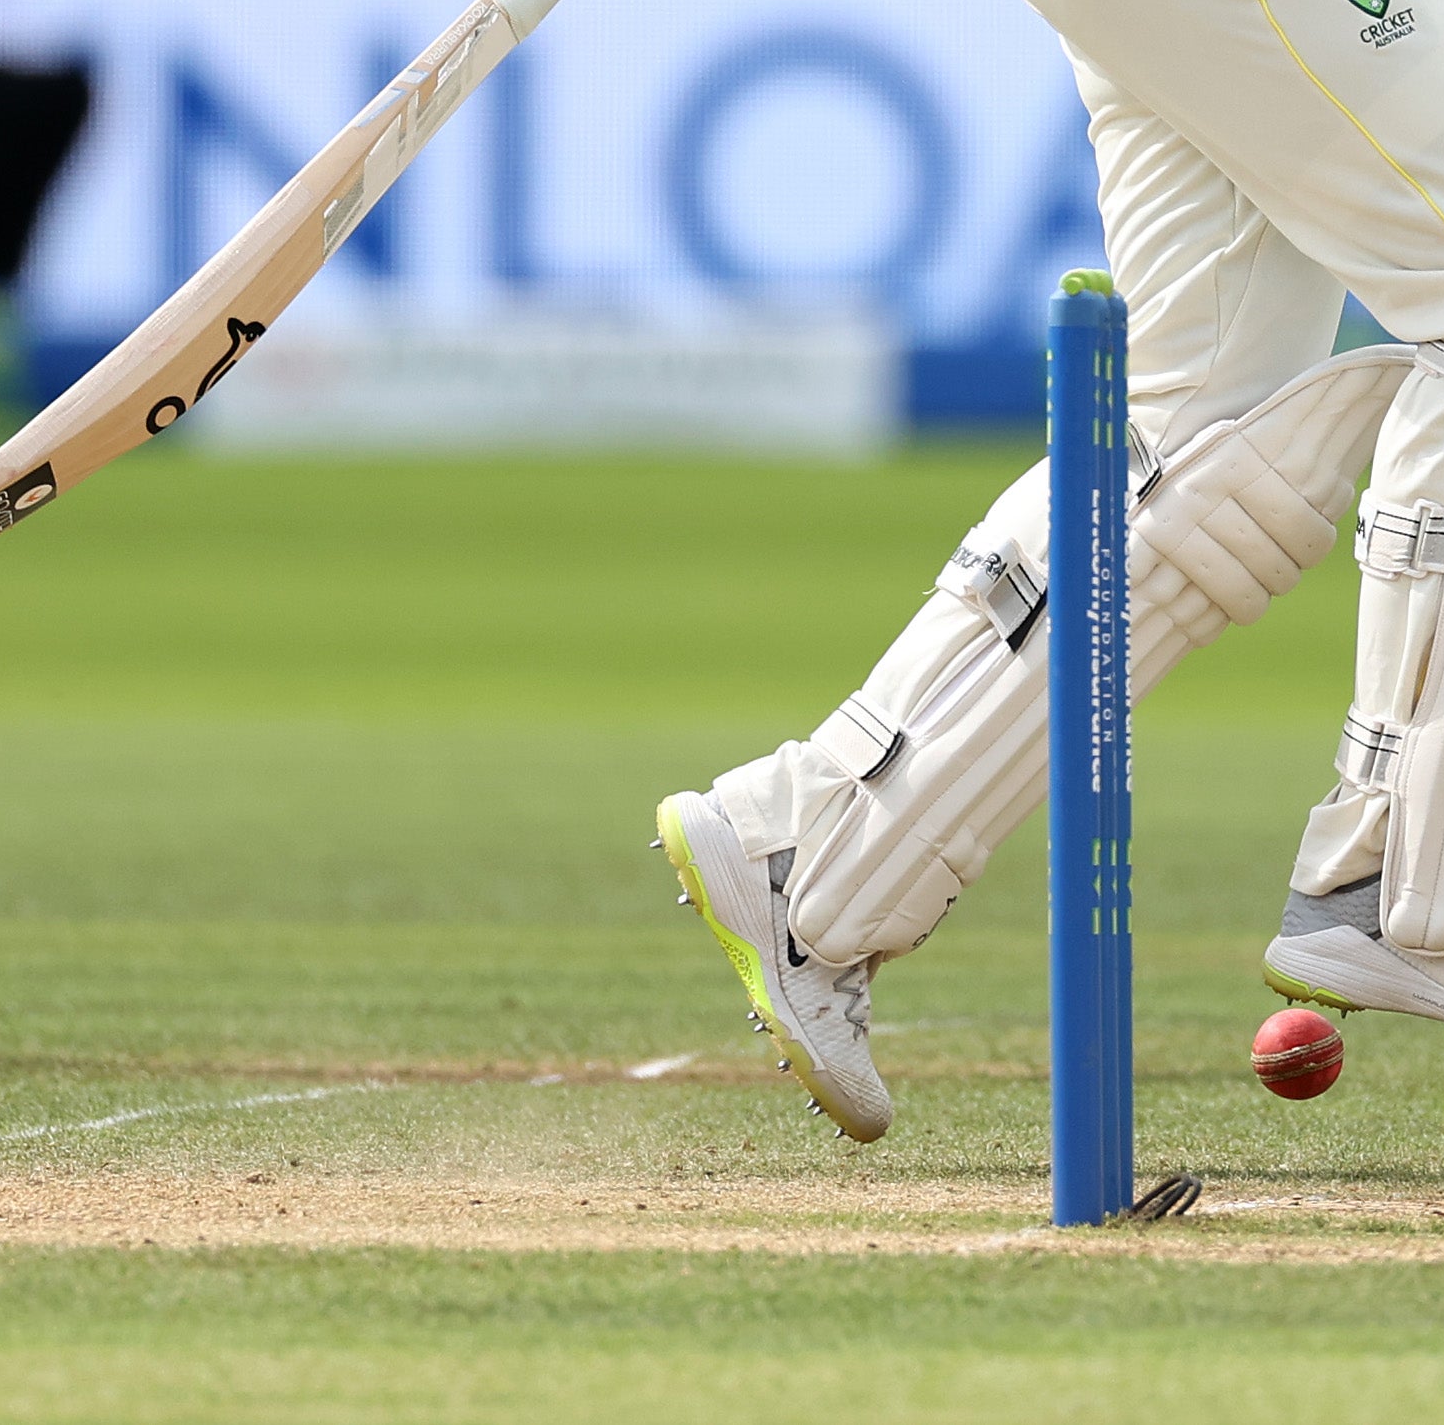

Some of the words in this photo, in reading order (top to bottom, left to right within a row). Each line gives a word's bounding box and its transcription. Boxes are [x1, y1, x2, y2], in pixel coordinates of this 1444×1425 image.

[423, 2, 488, 65] KOOKABURRA
[1360, 7, 1414, 43] CRICKET
[1375, 25, 1415, 49] AUSTRALIA
[1101, 548, 1112, 742] FOUNDATION
